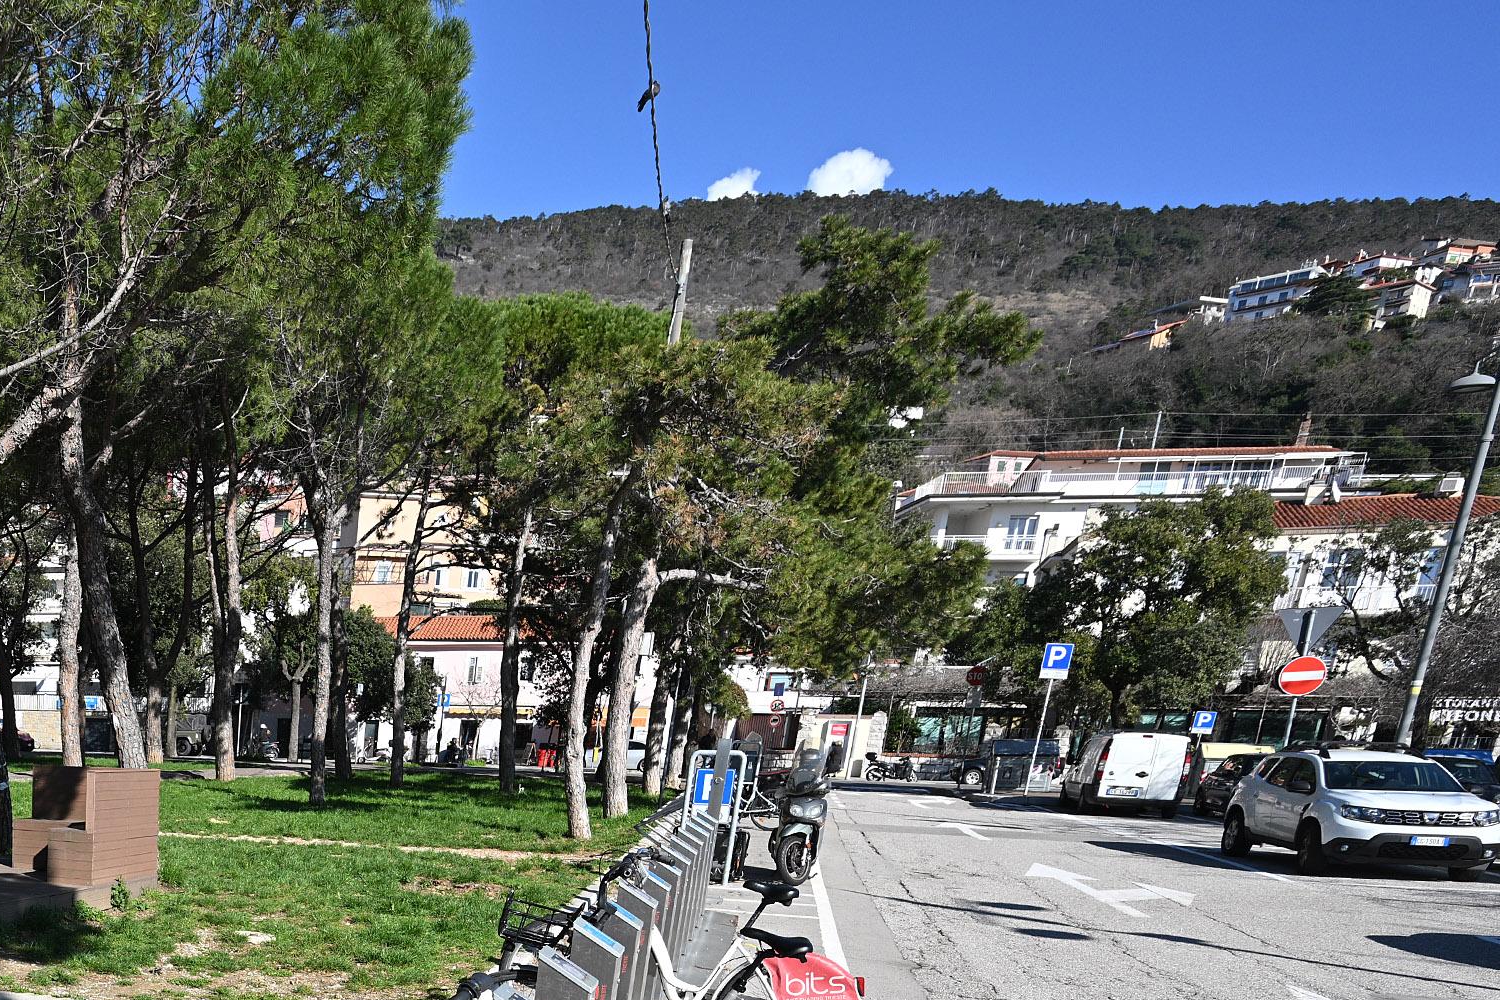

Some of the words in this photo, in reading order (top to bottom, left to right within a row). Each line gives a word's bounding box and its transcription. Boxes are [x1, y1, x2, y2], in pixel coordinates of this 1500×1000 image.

[1047, 646, 1067, 667] P
[1197, 713, 1212, 727] P
[785, 972, 846, 996] bits
